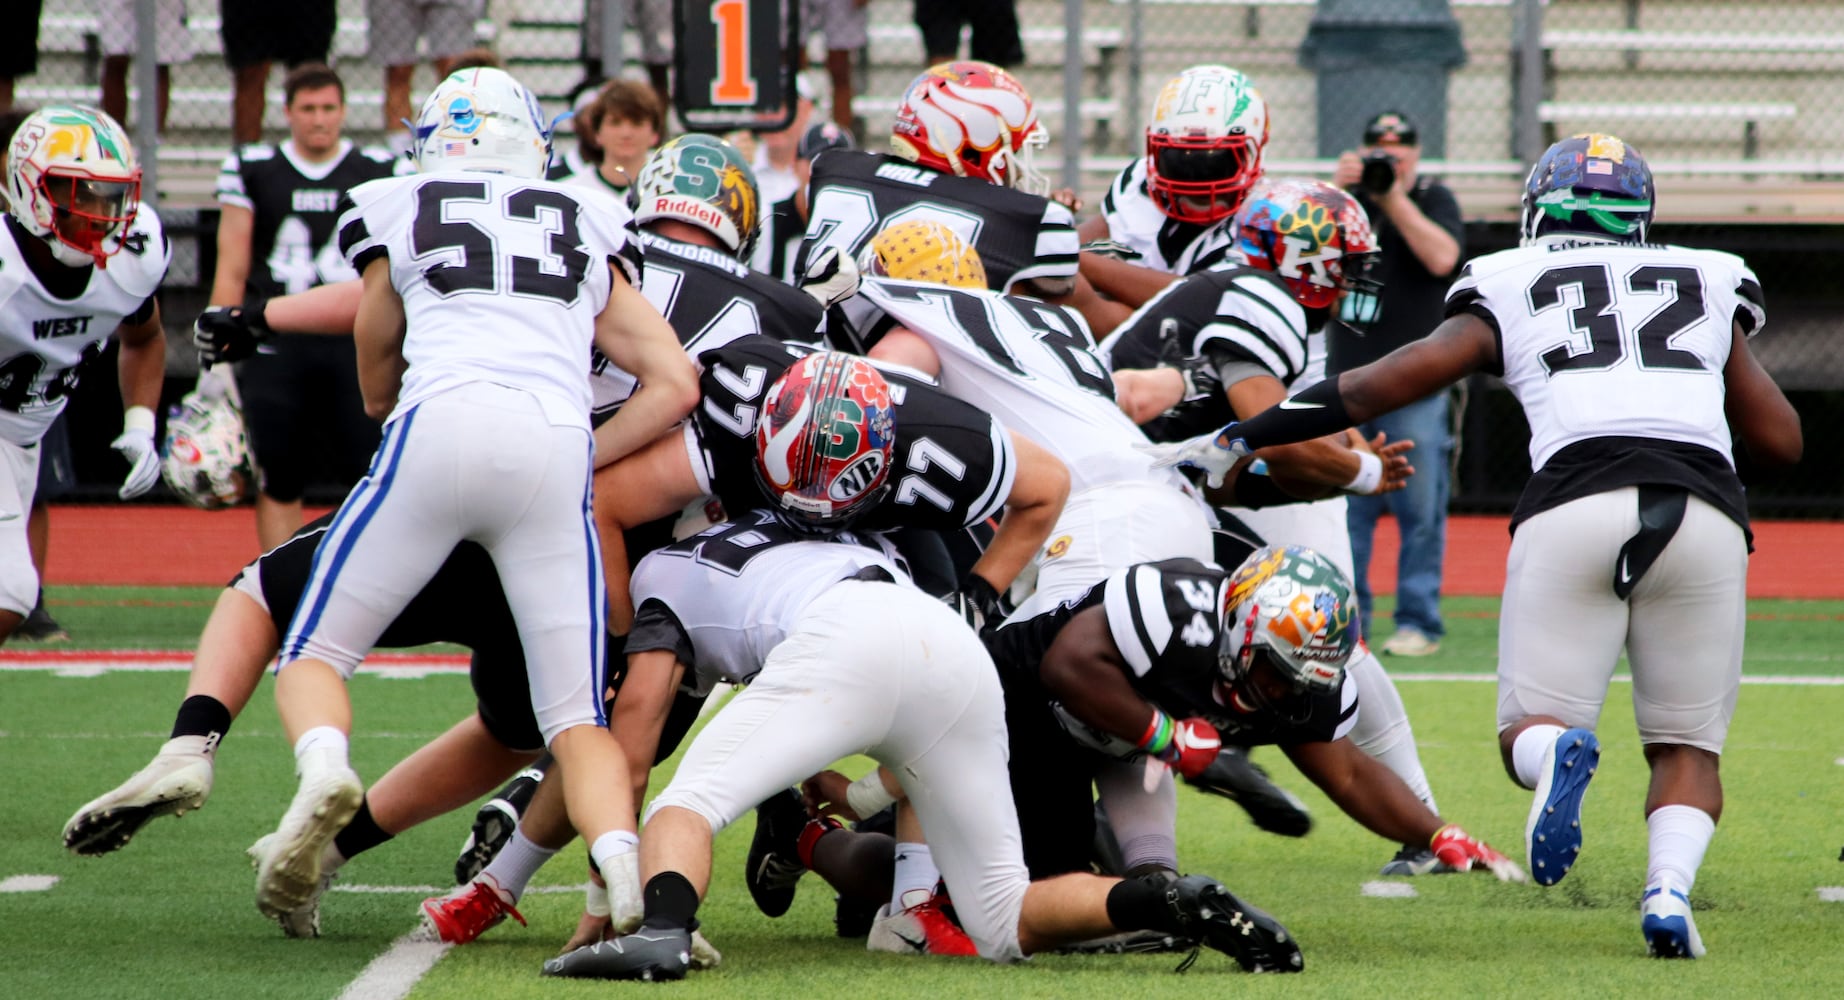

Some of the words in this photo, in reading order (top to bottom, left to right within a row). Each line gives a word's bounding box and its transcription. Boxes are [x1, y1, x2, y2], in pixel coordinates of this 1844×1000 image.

[711, 0, 758, 106] 1
[1176, 74, 1224, 115] F
[291, 189, 339, 212] EAST
[673, 144, 727, 201] S
[874, 162, 939, 188] HALE
[655, 198, 722, 229] Riddell
[409, 178, 596, 310] 53
[1279, 235, 1342, 289] K
[32, 316, 94, 341] WEST
[864, 278, 1118, 401] 78
[1525, 262, 1714, 382] 32
[702, 364, 768, 440] 77
[837, 457, 880, 497] NB
[895, 436, 967, 512] 77
[1175, 579, 1215, 648] 34
